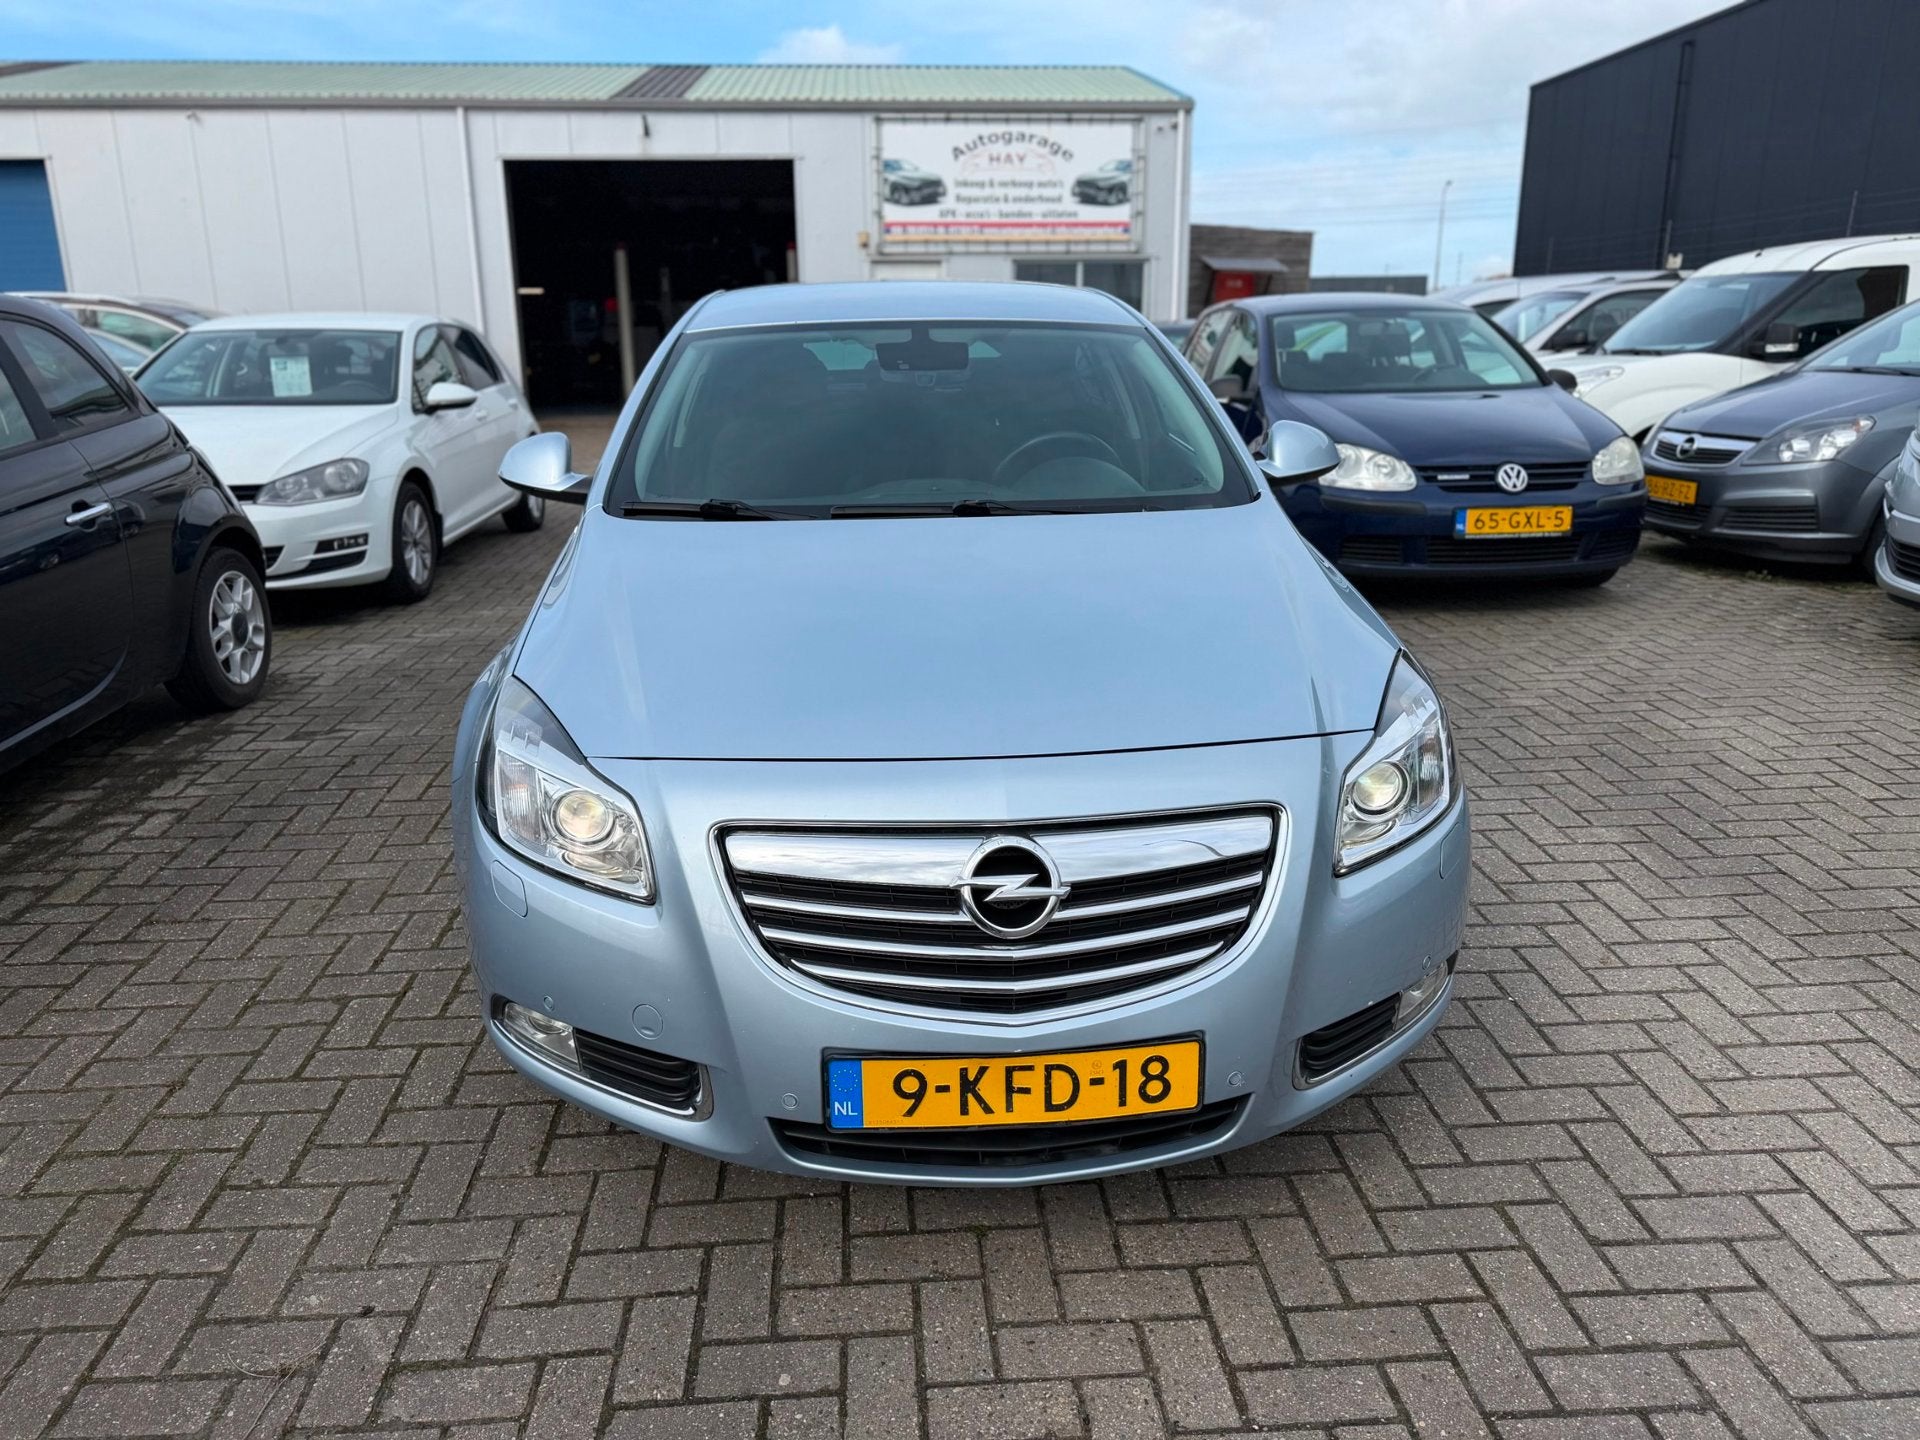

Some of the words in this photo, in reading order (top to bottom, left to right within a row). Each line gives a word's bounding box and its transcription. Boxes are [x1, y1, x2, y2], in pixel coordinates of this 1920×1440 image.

[952, 130, 1075, 163] Autogarage
[988, 152, 1028, 165] HAY
[1474, 510, 1565, 530] 65-GXL-5
[892, 1054, 1171, 1117] 9-KFD-18
[834, 1101, 858, 1116] NL
